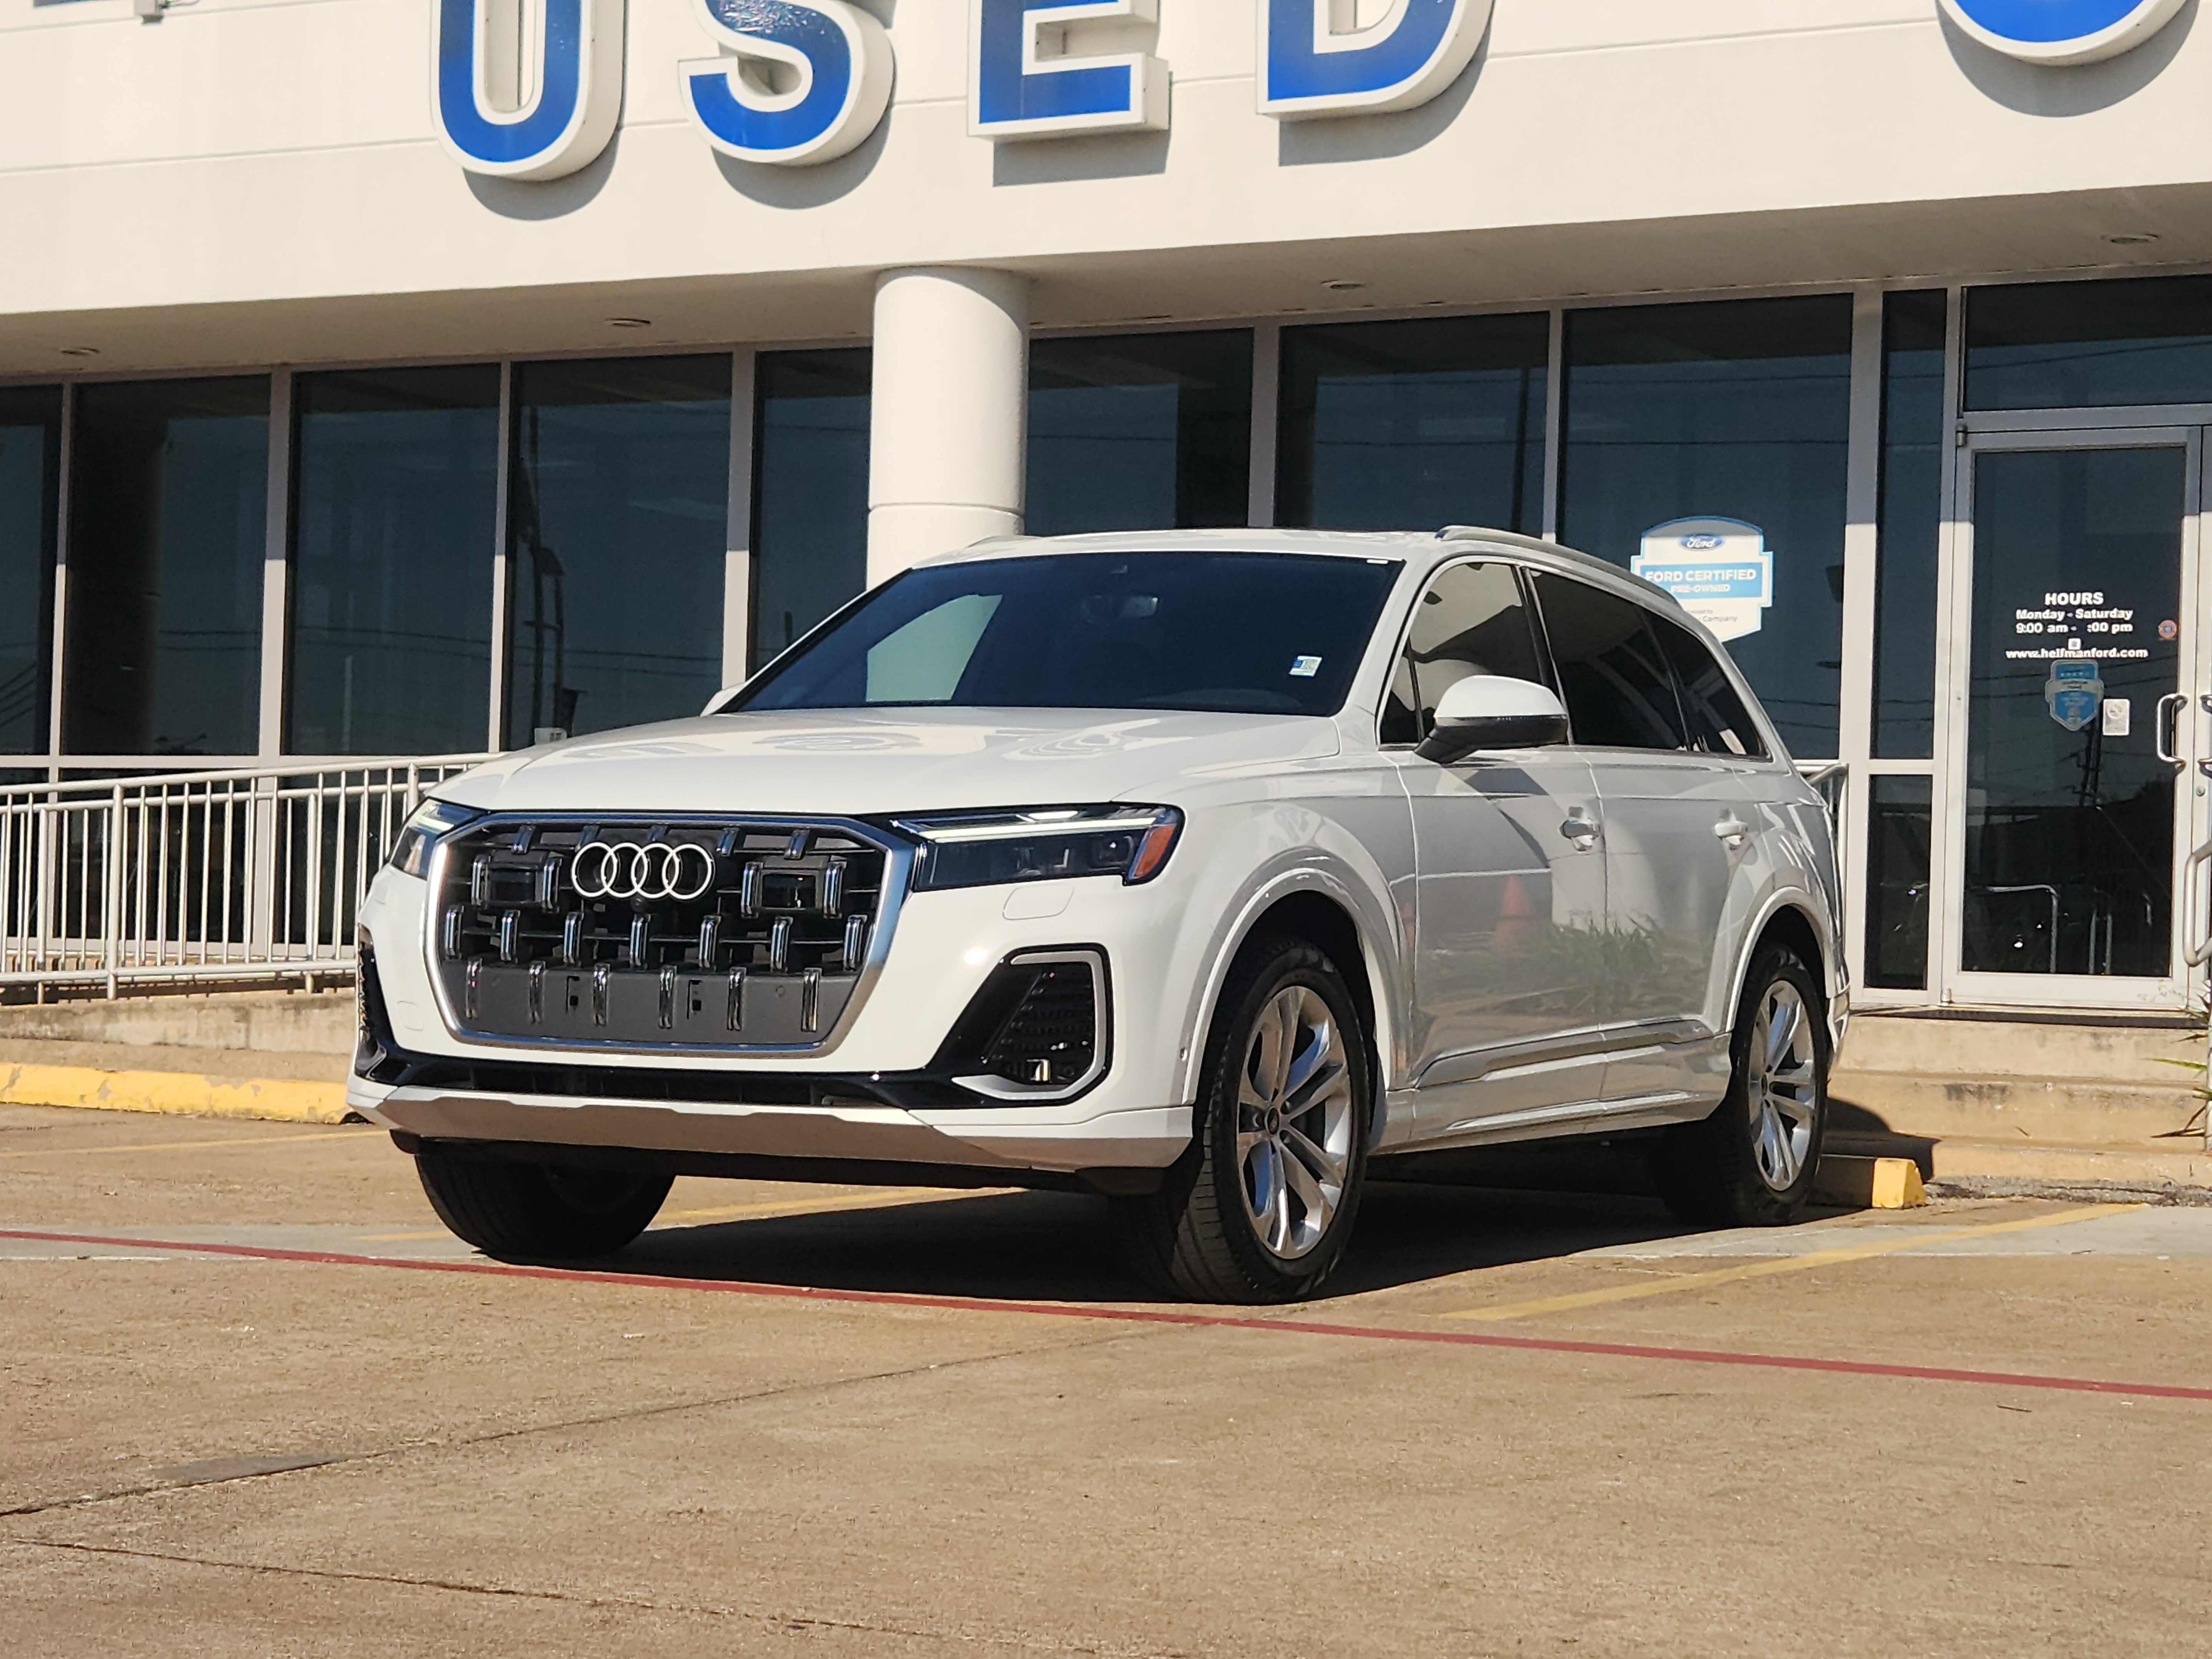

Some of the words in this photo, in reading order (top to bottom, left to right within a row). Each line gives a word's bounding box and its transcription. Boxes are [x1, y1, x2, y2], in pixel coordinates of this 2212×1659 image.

[1687, 536, 1716, 548] Ford
[1645, 571, 1682, 582] FORD
[1686, 569, 1756, 580] CERTIFIED
[1671, 584, 1730, 593] PRE-OWNED
[2045, 592, 2104, 606] HOURS
[2016, 609, 2065, 622] Monday
[2075, 608, 2134, 621] Saturday
[2016, 622, 2043, 633] 9:00
[2047, 624, 2069, 633] am
[2111, 624, 2134, 634] pm
